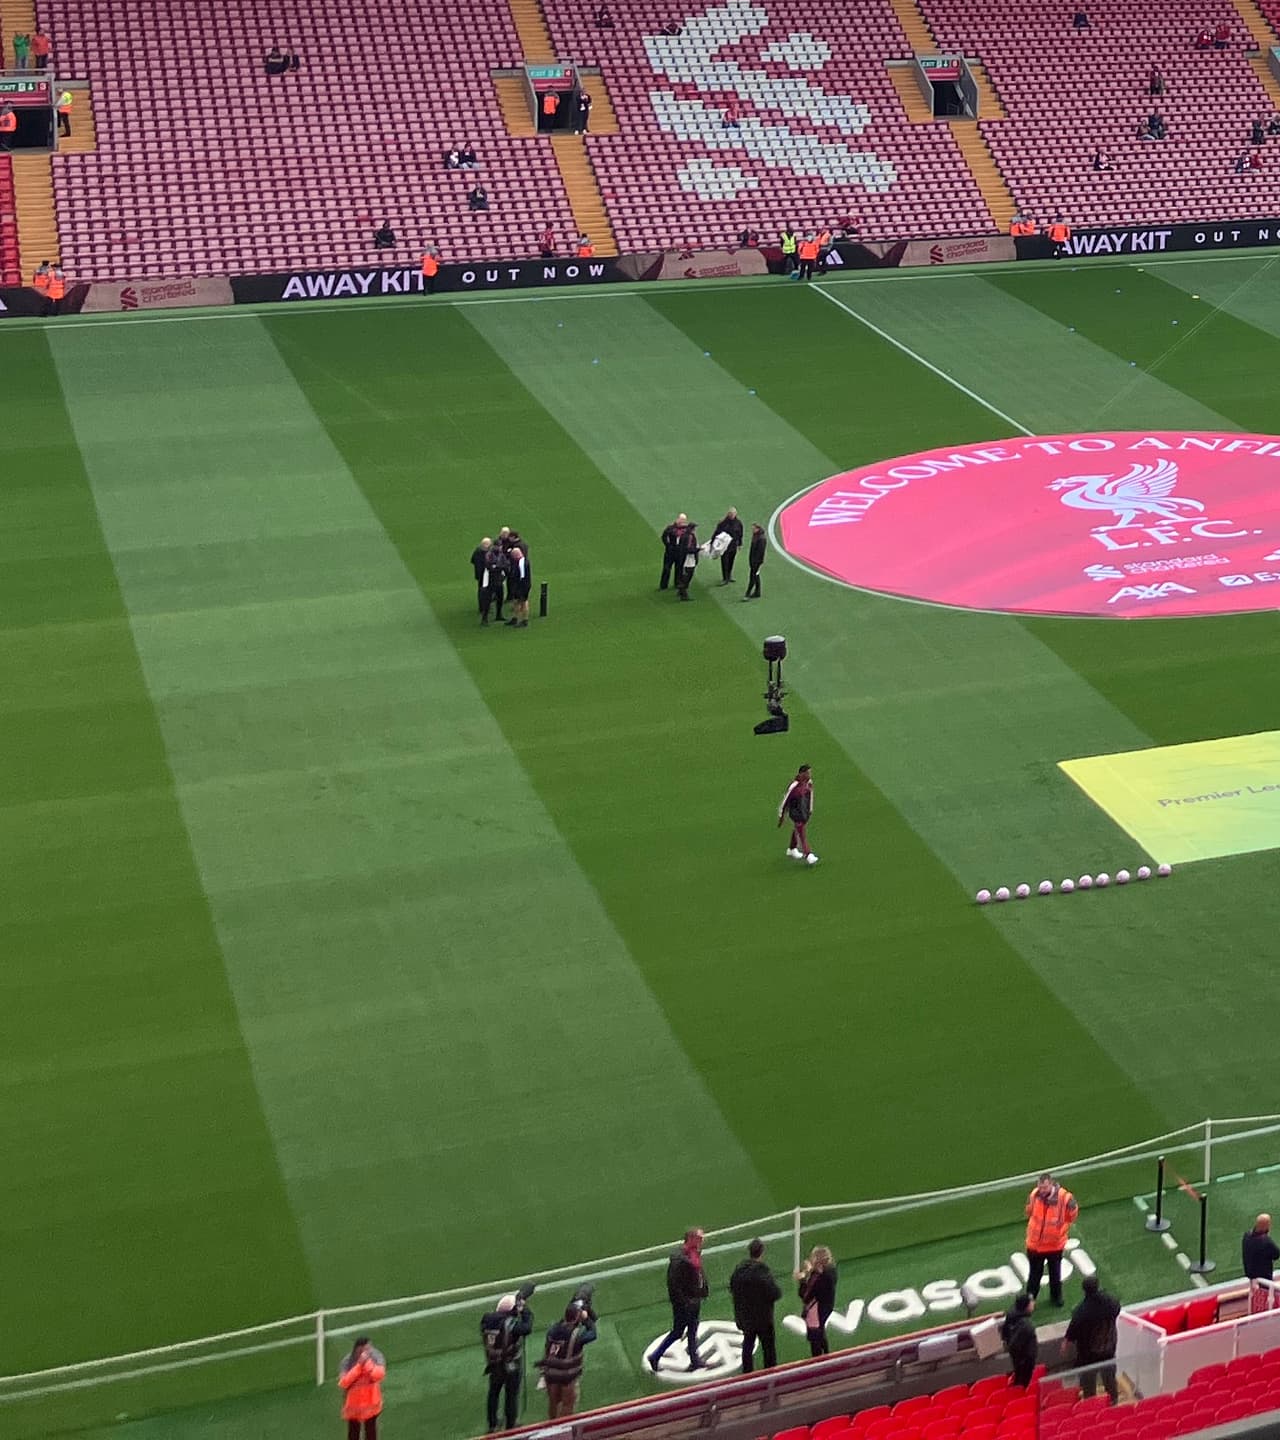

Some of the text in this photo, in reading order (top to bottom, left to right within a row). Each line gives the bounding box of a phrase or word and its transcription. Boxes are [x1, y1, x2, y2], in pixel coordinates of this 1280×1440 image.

[946, 239, 988, 260] standard chartered
[1062, 233, 1129, 255] AWAY
[1131, 230, 1172, 251] KIT
[1194, 230, 1241, 243] OUT
[140, 280, 196, 304] standard chartered
[282, 264, 604, 299] AWAY KIT OUT NOW
[808, 446, 1022, 527] WELCOME
[1023, 438, 1116, 456] TO
[1089, 520, 1263, 551] L.F.C.
[1123, 553, 1231, 574] standard chartered
[1107, 582, 1198, 603] AXA
[1158, 788, 1243, 809] Premier
[782, 1238, 1096, 1337] wasabi
